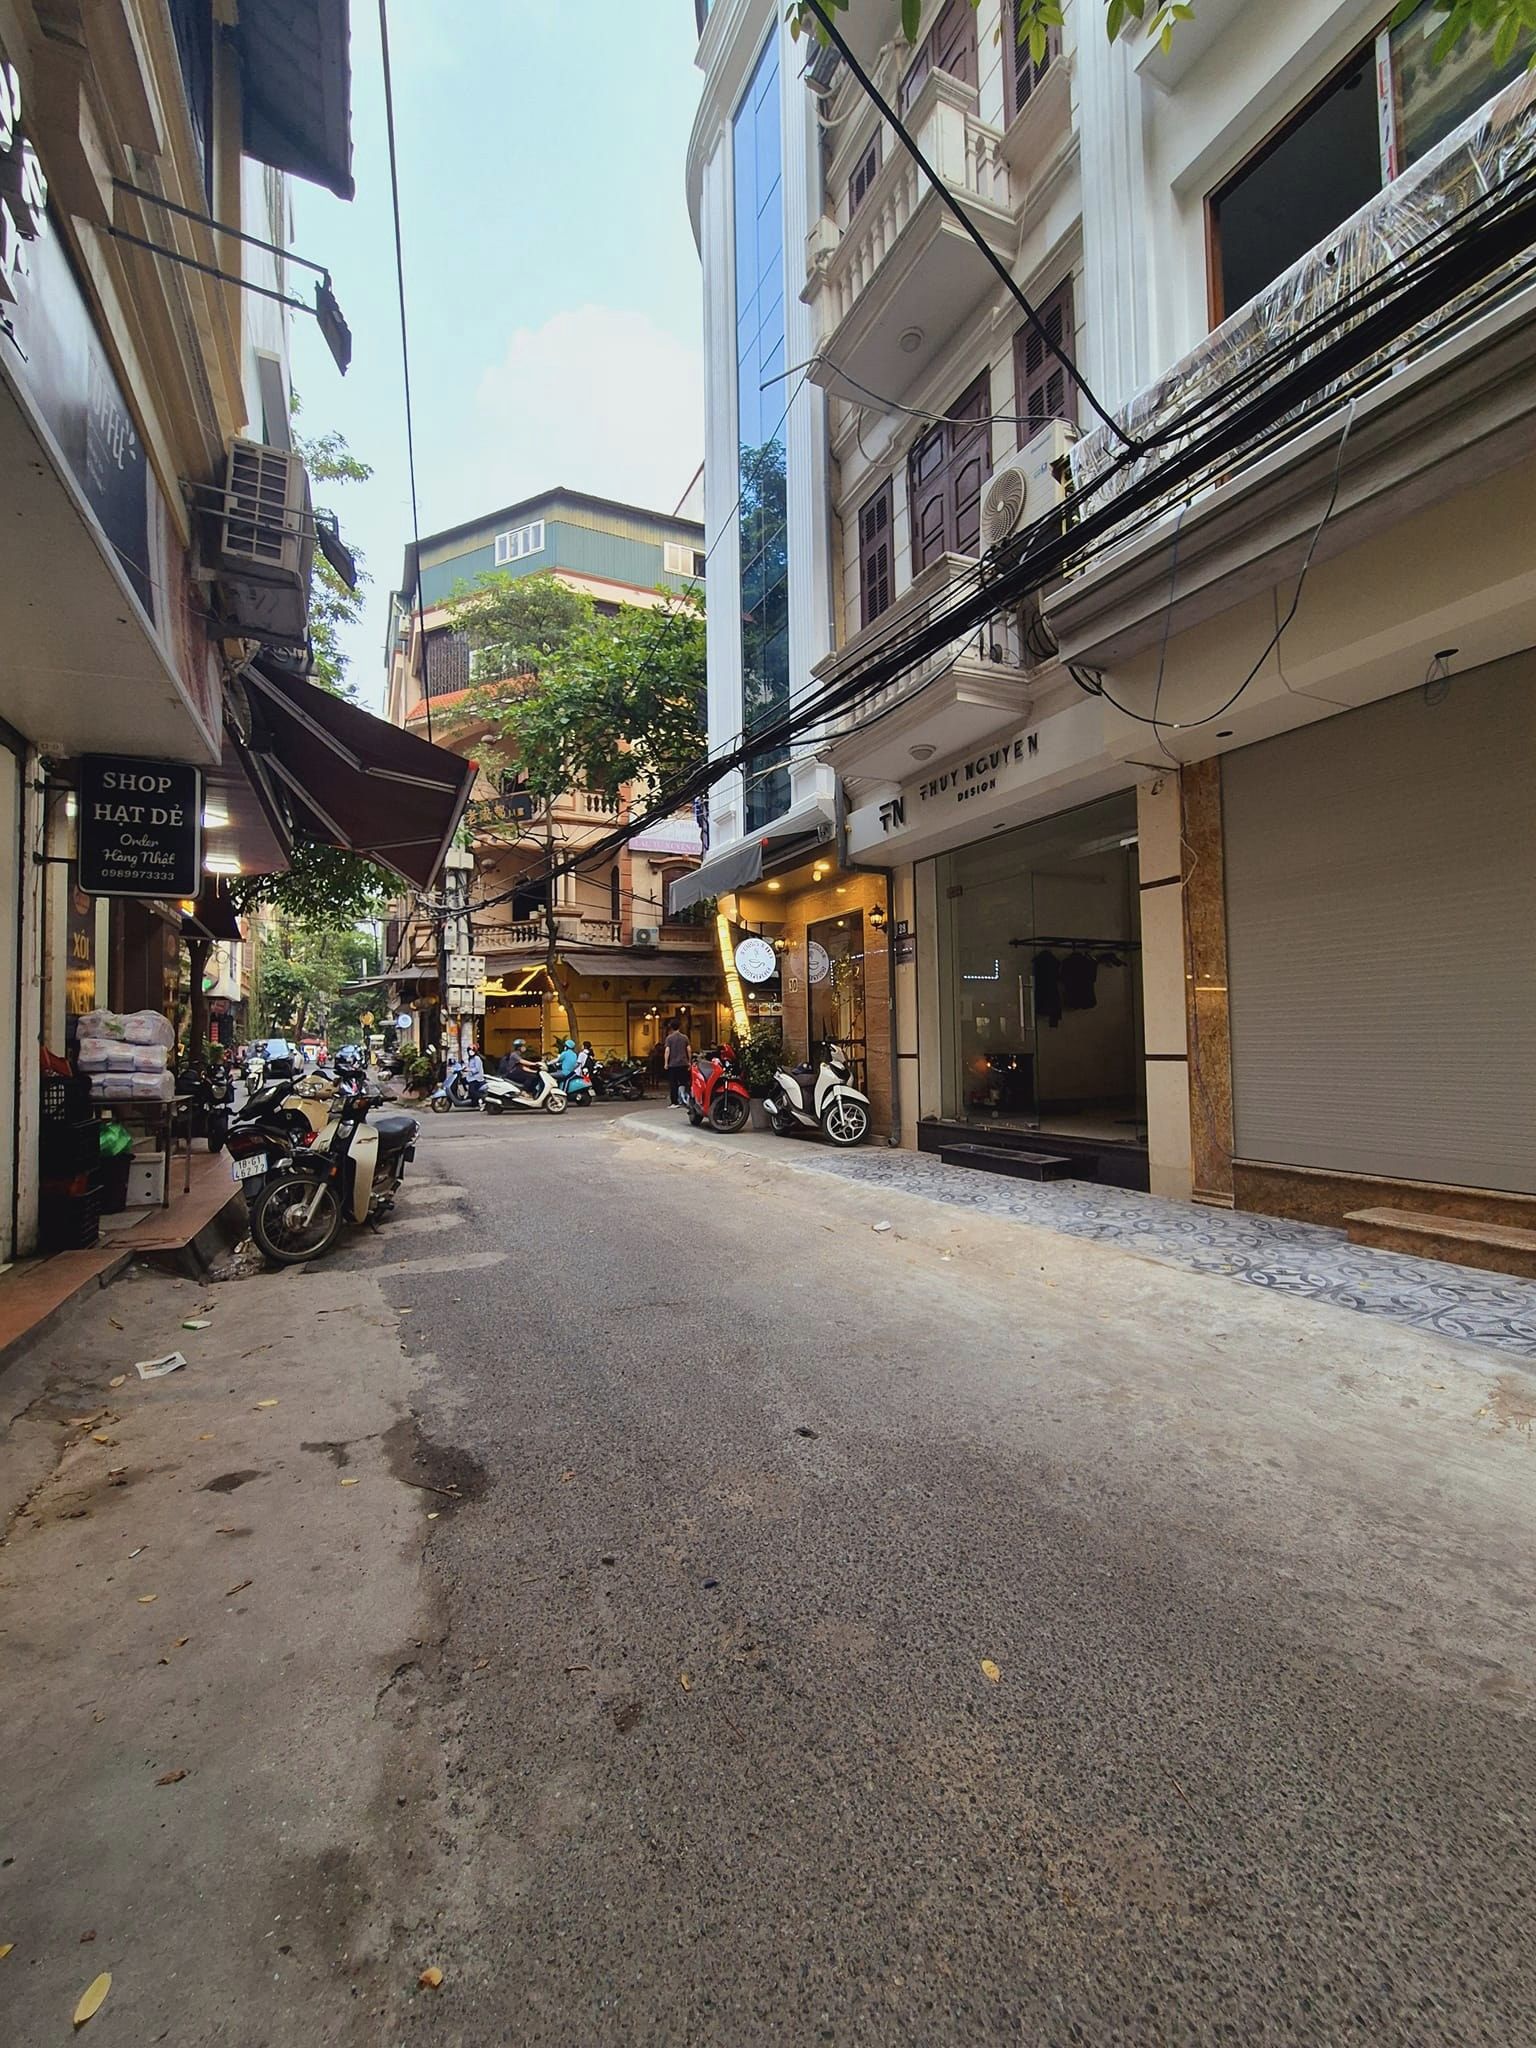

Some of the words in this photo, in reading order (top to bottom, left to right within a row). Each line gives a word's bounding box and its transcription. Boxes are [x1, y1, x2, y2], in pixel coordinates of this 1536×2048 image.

[964, 732, 1038, 781] NGUYEN
[103, 771, 172, 793] SHOP
[957, 778, 996, 802] DESIGN
[94, 803, 145, 826] HẠT
[150, 803, 183, 827] DẺ
[120, 833, 159, 847] Order
[103, 848, 138, 868] Hàng
[141, 851, 175, 867] Nhật
[101, 868, 175, 881] 0989973333
